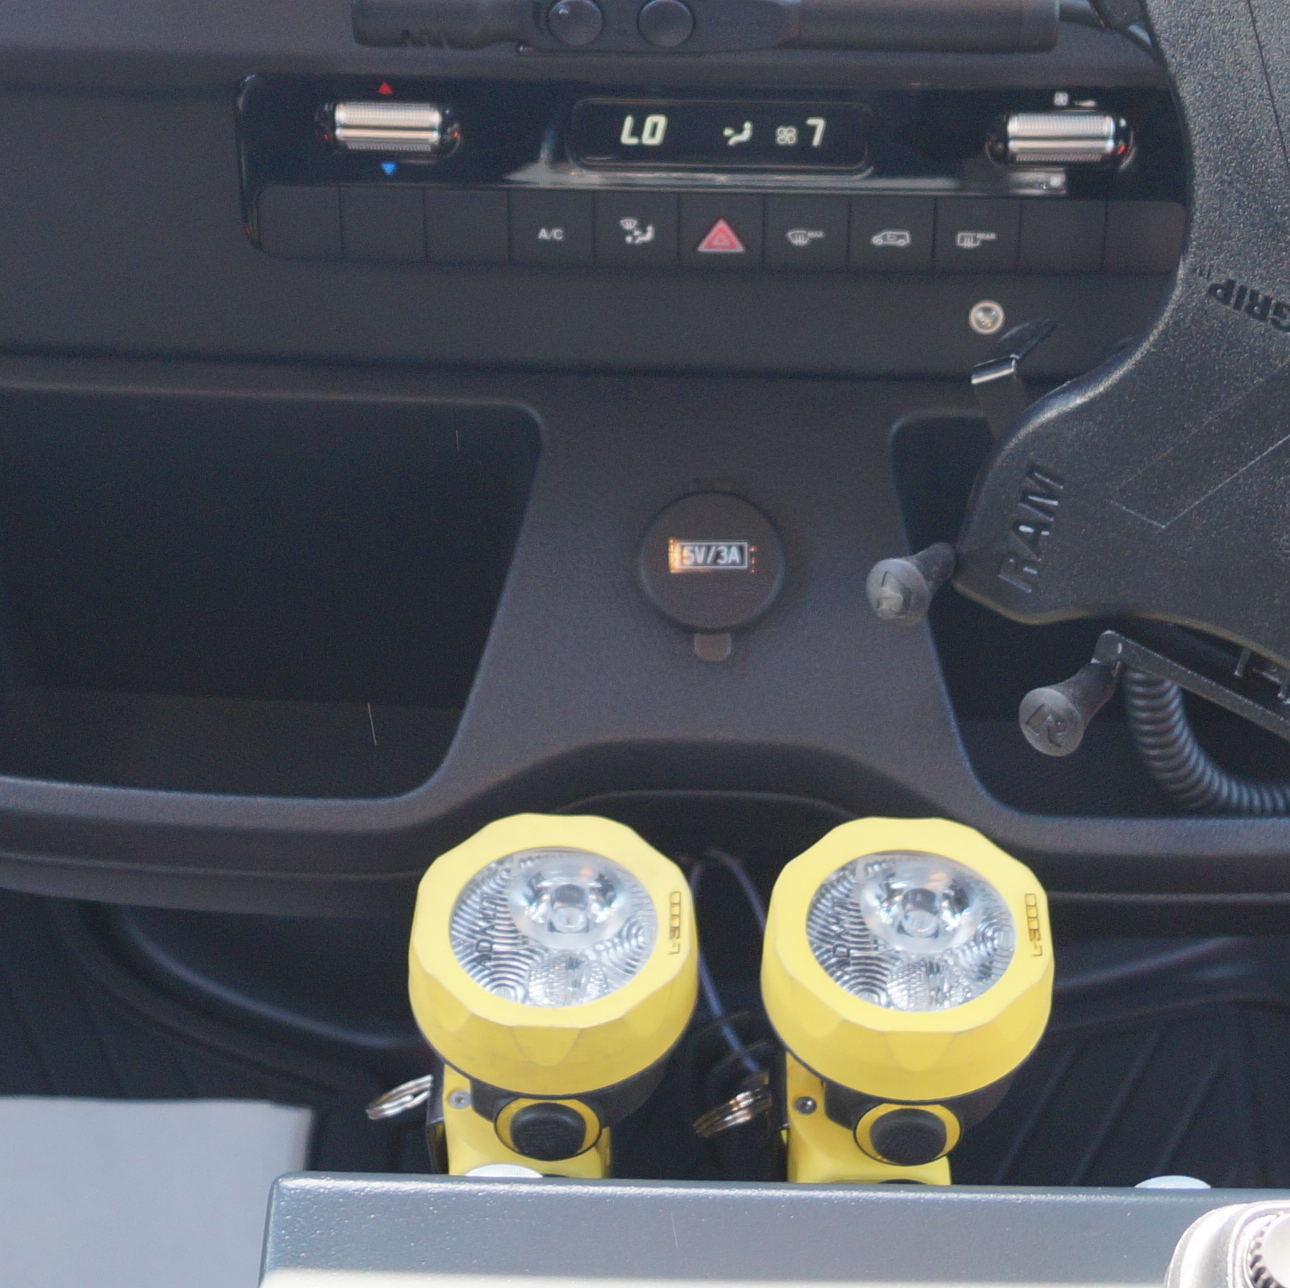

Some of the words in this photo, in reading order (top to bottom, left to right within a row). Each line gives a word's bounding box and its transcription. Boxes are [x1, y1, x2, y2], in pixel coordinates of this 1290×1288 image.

[620, 114, 667, 146] LO
[806, 116, 826, 147] 7
[537, 227, 564, 241] A/C
[997, 463, 1064, 594] RAM
[682, 545, 741, 566] 5V/3A
